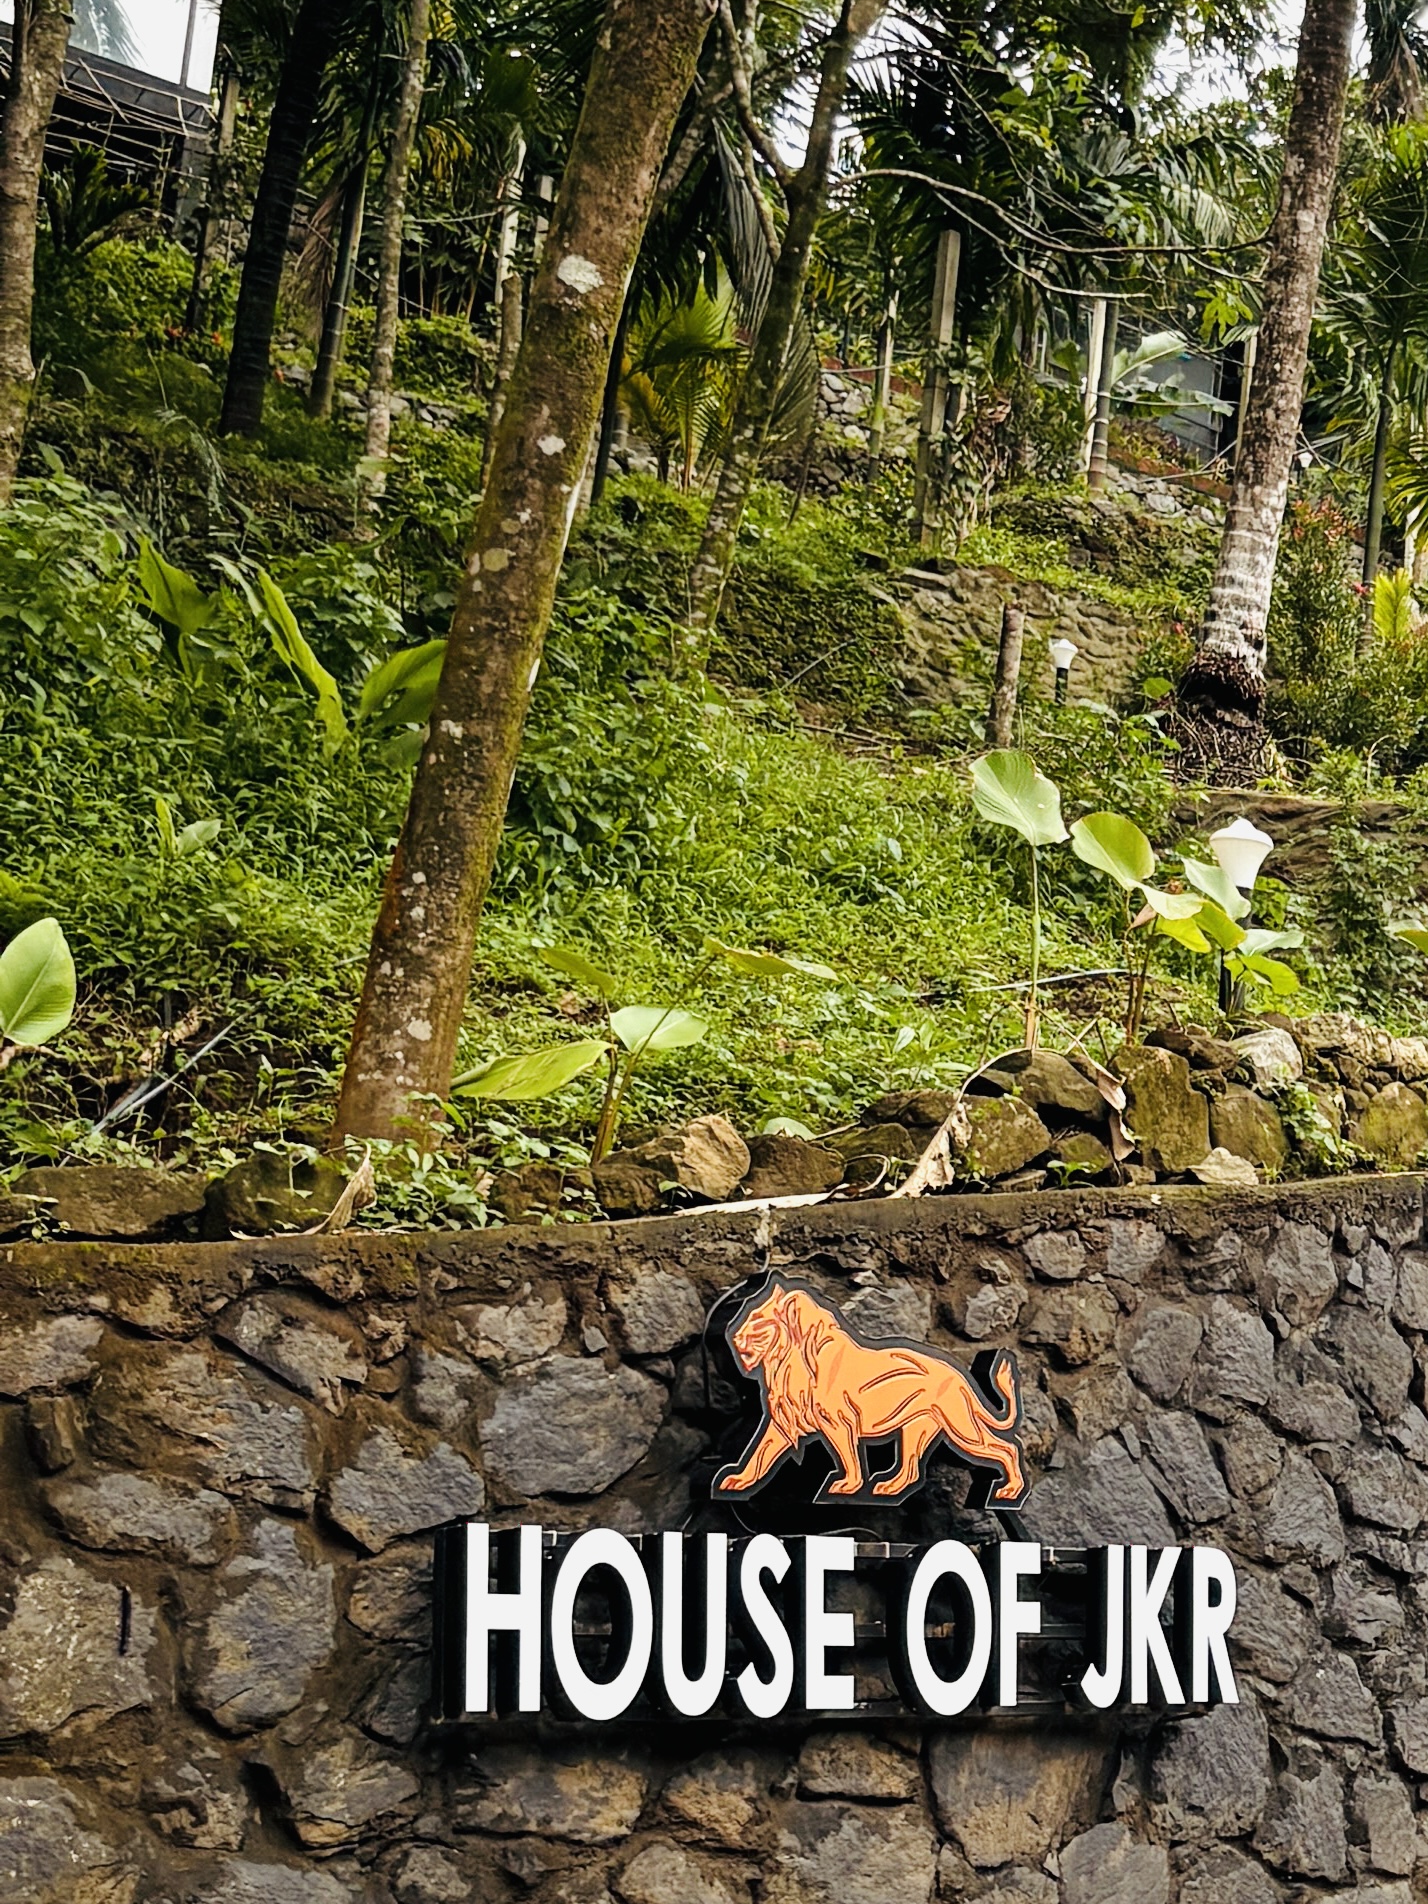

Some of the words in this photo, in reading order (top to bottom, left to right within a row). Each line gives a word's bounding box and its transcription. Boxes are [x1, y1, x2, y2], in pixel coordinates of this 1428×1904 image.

[465, 1523, 855, 1720] HOUSE
[906, 1539, 1041, 1716] OF
[1081, 1544, 1240, 1708] JKR
